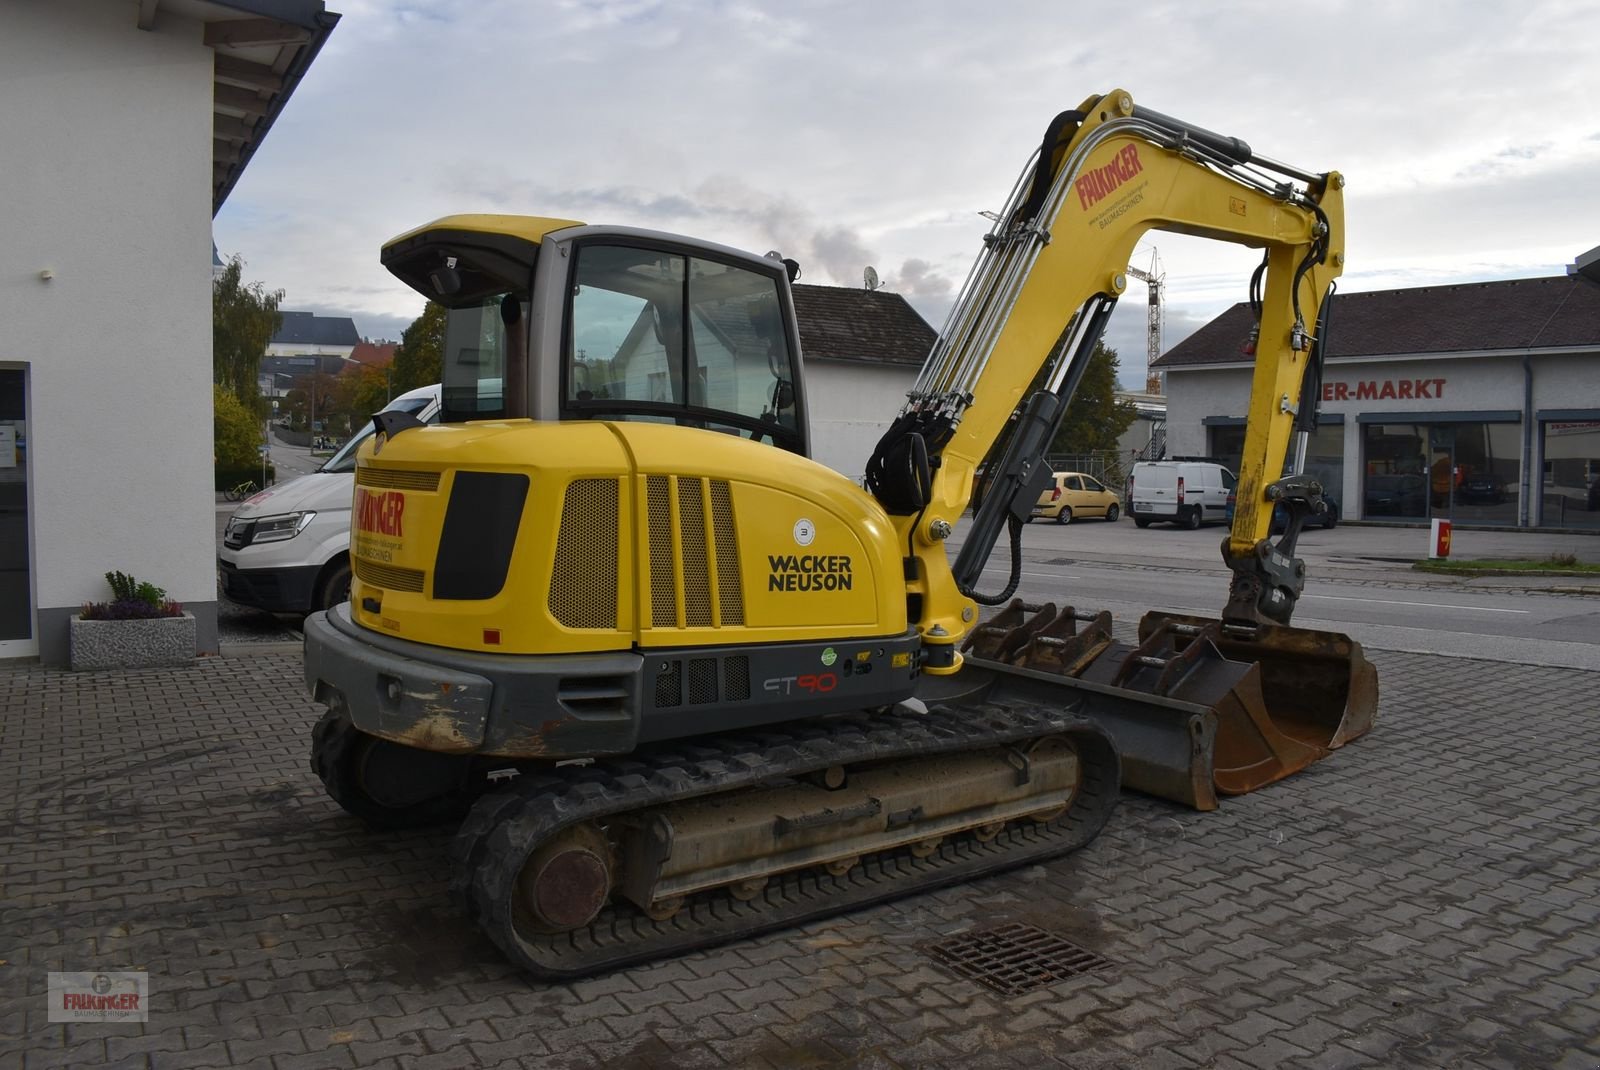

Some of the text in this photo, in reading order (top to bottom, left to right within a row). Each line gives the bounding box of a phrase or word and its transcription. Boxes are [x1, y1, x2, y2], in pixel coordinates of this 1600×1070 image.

[1075, 143, 1143, 211] FALKINGER
[1098, 193, 1144, 229] BAUMASCHINEN
[1321, 379, 1446, 401] ER-MARKT
[768, 555, 852, 573] WACKER
[768, 574, 853, 592] NEUSON
